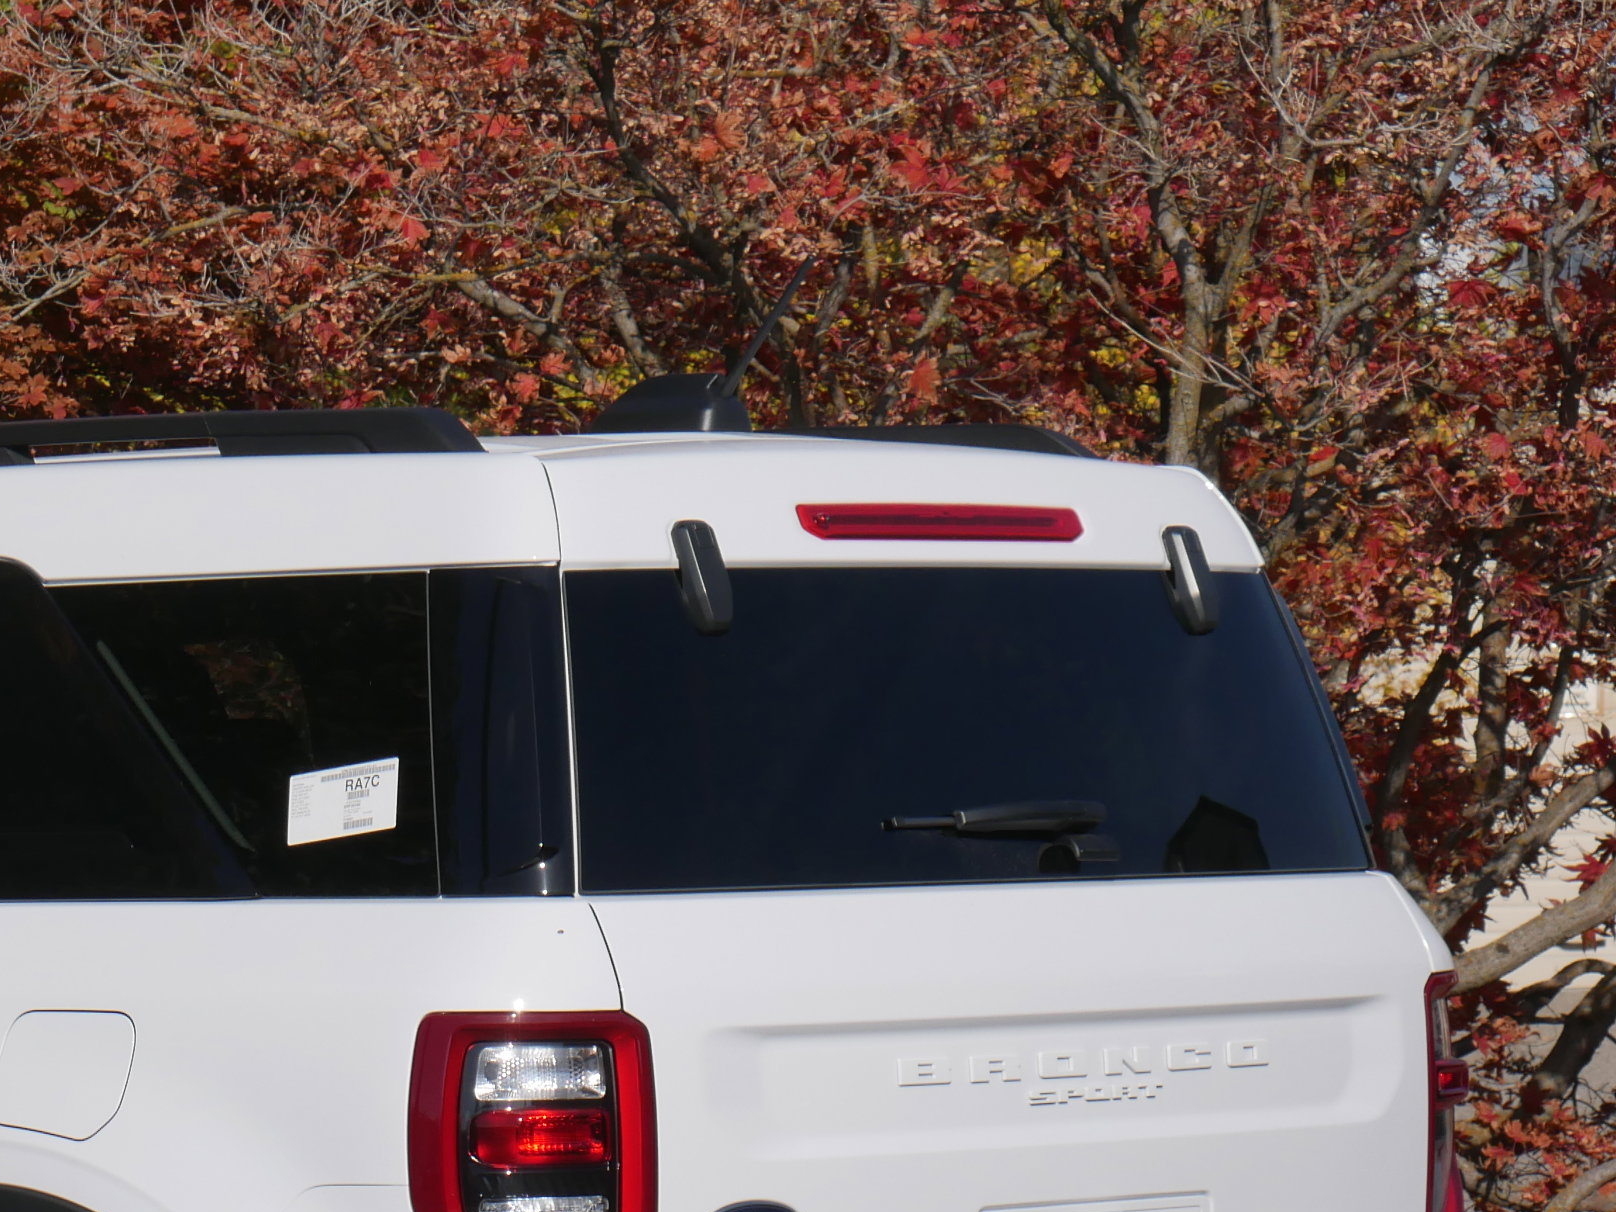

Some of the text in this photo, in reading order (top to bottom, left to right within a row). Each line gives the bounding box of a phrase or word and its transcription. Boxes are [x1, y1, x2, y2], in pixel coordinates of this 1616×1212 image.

[345, 775, 380, 791] RA7C
[897, 1040, 1270, 1087] BRONCO
[1029, 1084, 1163, 1106] SPORT
